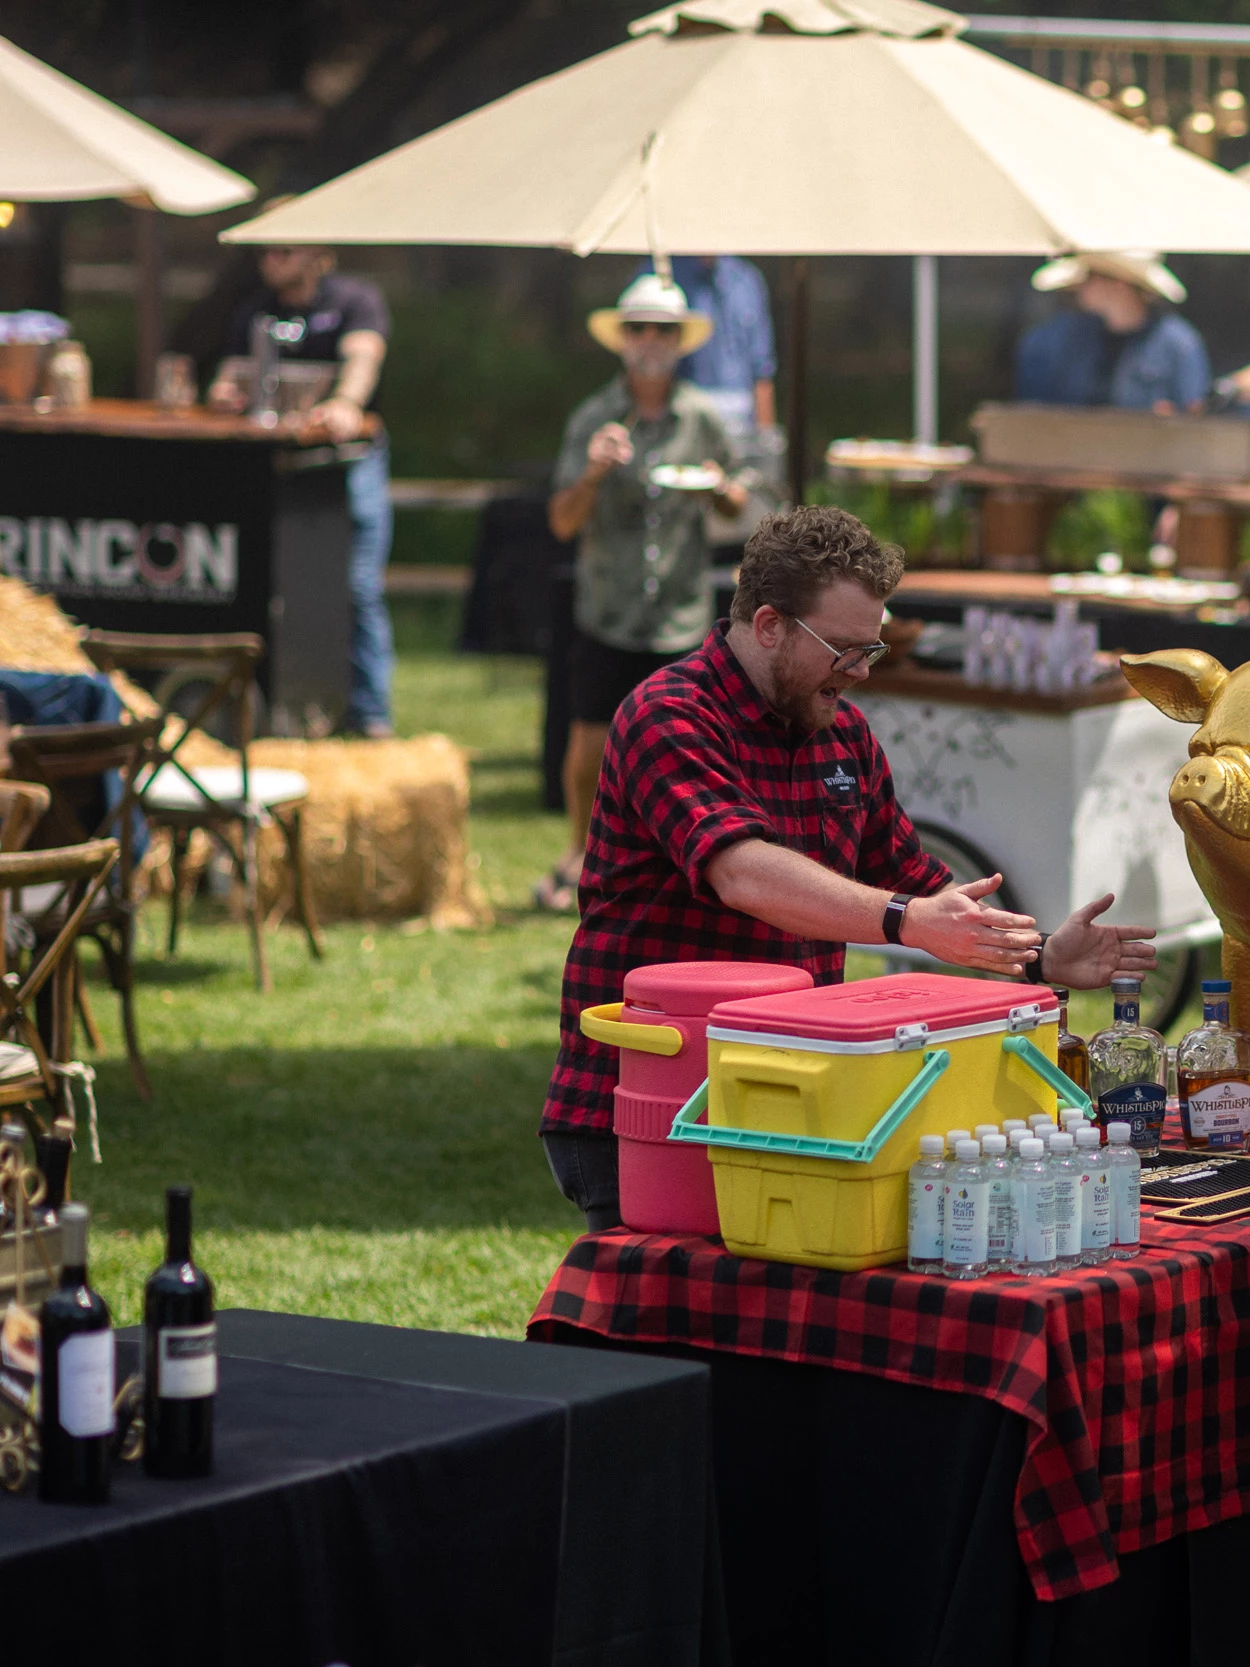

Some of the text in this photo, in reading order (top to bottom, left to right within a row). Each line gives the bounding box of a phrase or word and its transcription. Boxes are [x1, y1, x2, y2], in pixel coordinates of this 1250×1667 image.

[0, 515, 239, 592] RINCON
[1127, 1007, 1135, 1018] 15
[1133, 1120, 1142, 1131] 15
[1213, 1118, 1240, 1127] BOURBON
[1222, 1134, 1231, 1143] 10
[1094, 1185, 1109, 1194] Sola
[953, 1200, 975, 1209] Solar
[953, 1208, 975, 1217] Rain
